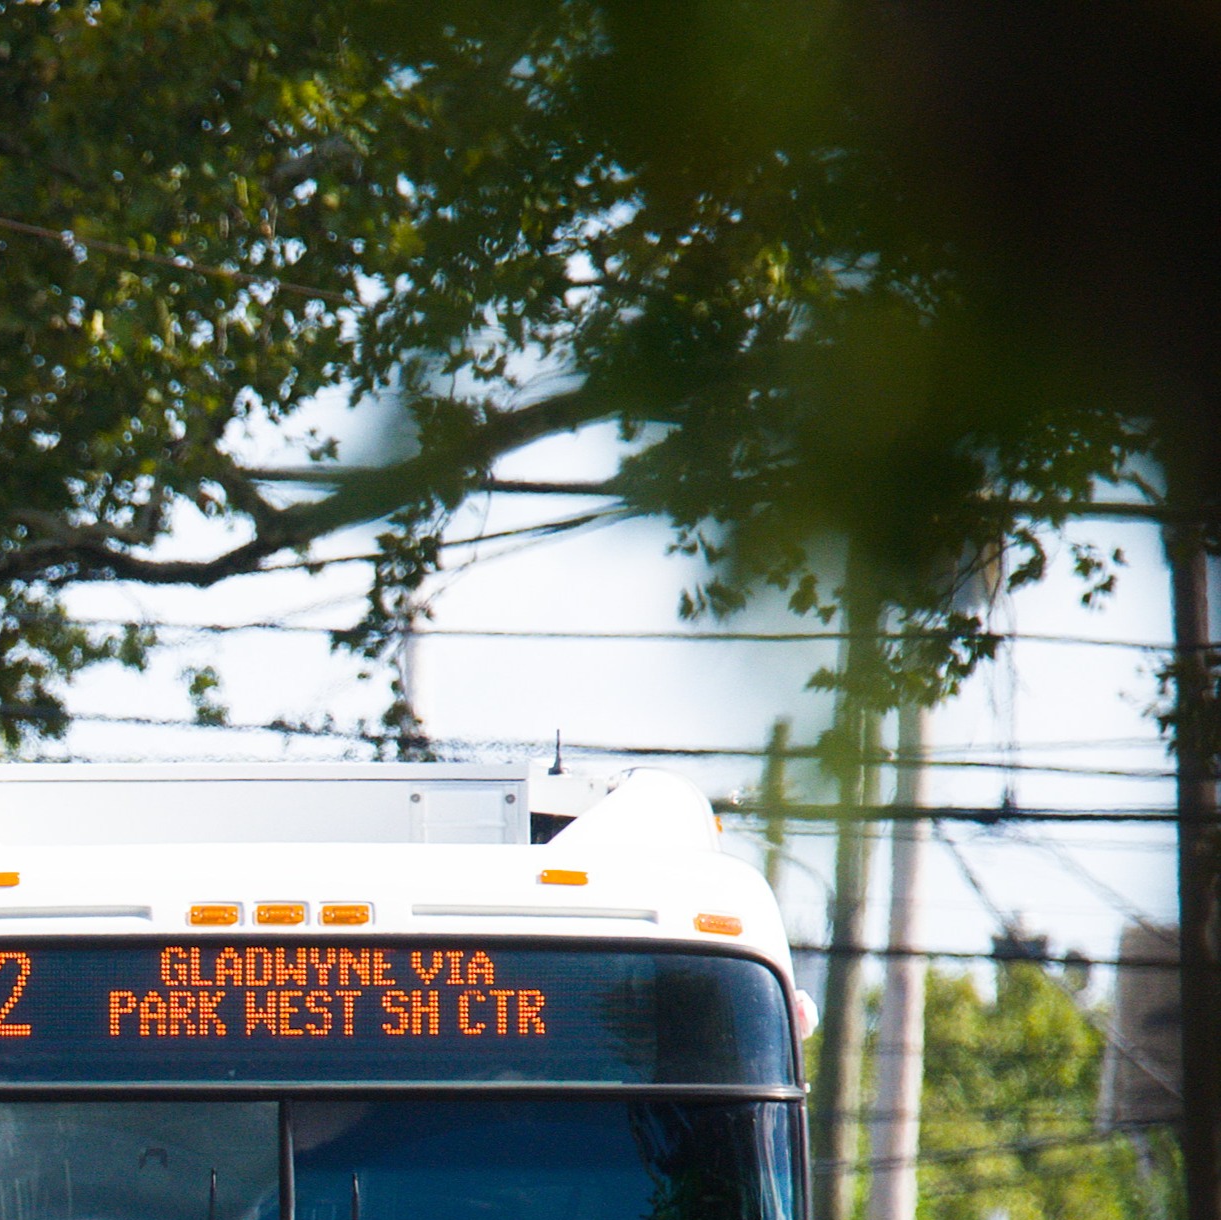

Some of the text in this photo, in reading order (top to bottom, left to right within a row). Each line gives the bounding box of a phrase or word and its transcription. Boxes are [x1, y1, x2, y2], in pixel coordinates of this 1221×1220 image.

[160, 945, 495, 987] GLADWYNE VIA
[109, 989, 547, 1036] PARK WEST SH CTR
